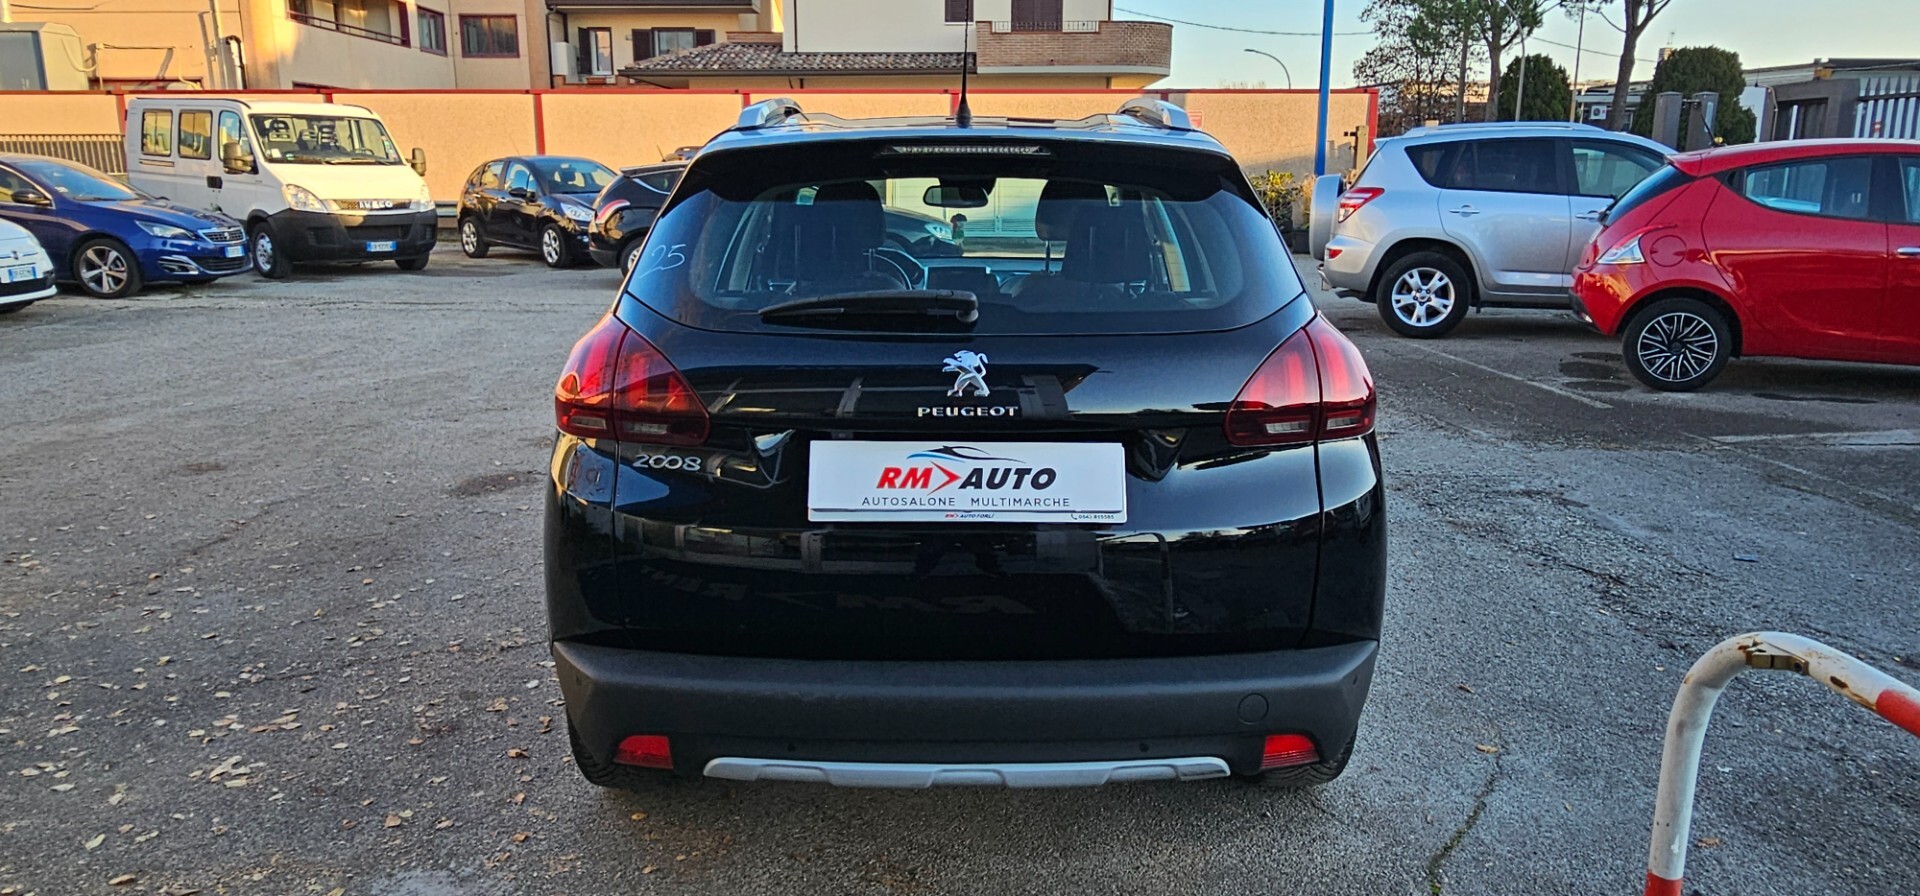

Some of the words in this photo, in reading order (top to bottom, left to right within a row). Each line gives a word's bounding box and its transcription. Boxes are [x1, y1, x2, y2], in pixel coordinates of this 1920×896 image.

[640, 243, 687, 279] 25
[917, 406, 1019, 417] PEUGEOT
[632, 454, 702, 471] 2008
[958, 467, 1057, 490] AUTO
[861, 497, 956, 506] AUTOSALONE
[970, 497, 1071, 507] MULTIMARCHE
